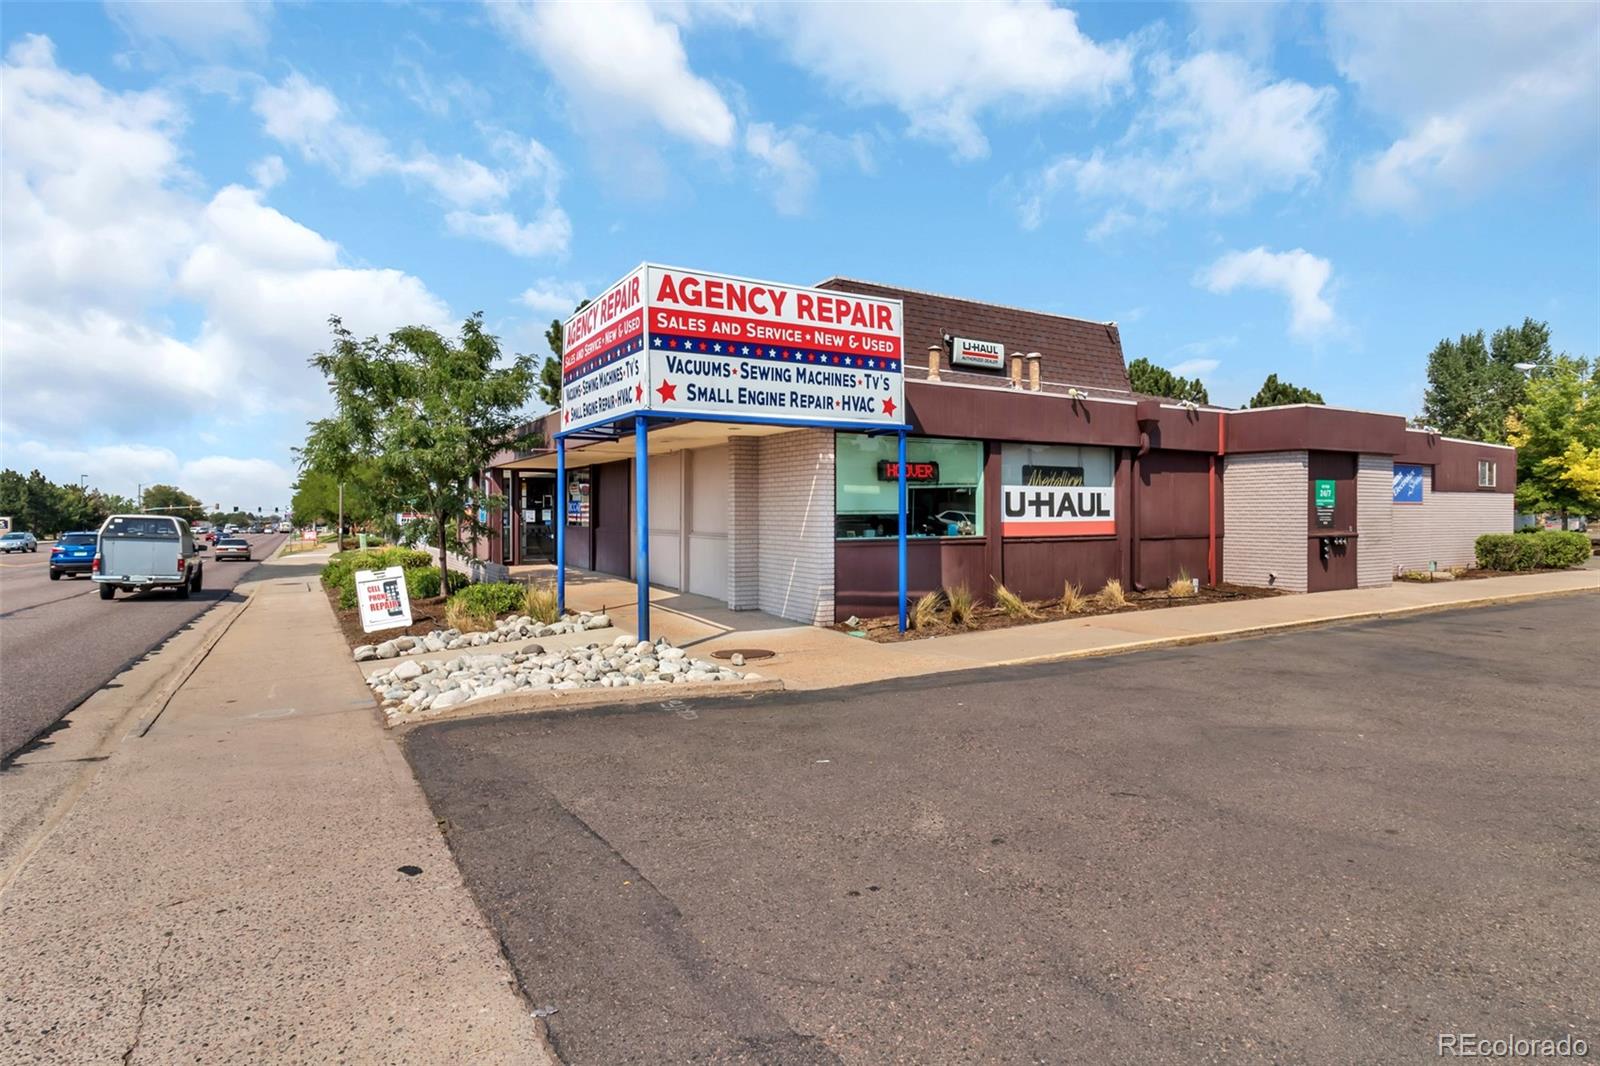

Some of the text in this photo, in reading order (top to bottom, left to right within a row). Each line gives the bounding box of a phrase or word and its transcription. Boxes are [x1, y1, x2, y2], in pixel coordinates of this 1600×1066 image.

[566, 276, 640, 349] AGENCY REPAIR
[656, 274, 893, 331] AGENCY REPAIR
[584, 337, 602, 356] SERVICE
[605, 327, 618, 344] NEW
[618, 323, 624, 338] &
[624, 317, 641, 334] USED
[657, 313, 894, 352] SALES AND SERVICE NEW & USED
[963, 341, 999, 354] U-HAUL
[582, 377, 599, 395] SEWING
[598, 366, 623, 388] MACHINES
[666, 355, 890, 391] VACUUMS SEWING MACHINES TV'S
[570, 386, 633, 421] SMALL ENGINE REPAIR HVAC
[687, 383, 875, 413] SMALL ENGINE REPAIR HVAC
[886, 463, 933, 478] HOVER
[1005, 492, 1110, 517] U-HAUL
[367, 585, 381, 593] CELL
[368, 593, 388, 602] PHONE
[370, 600, 401, 612] REPAIR
